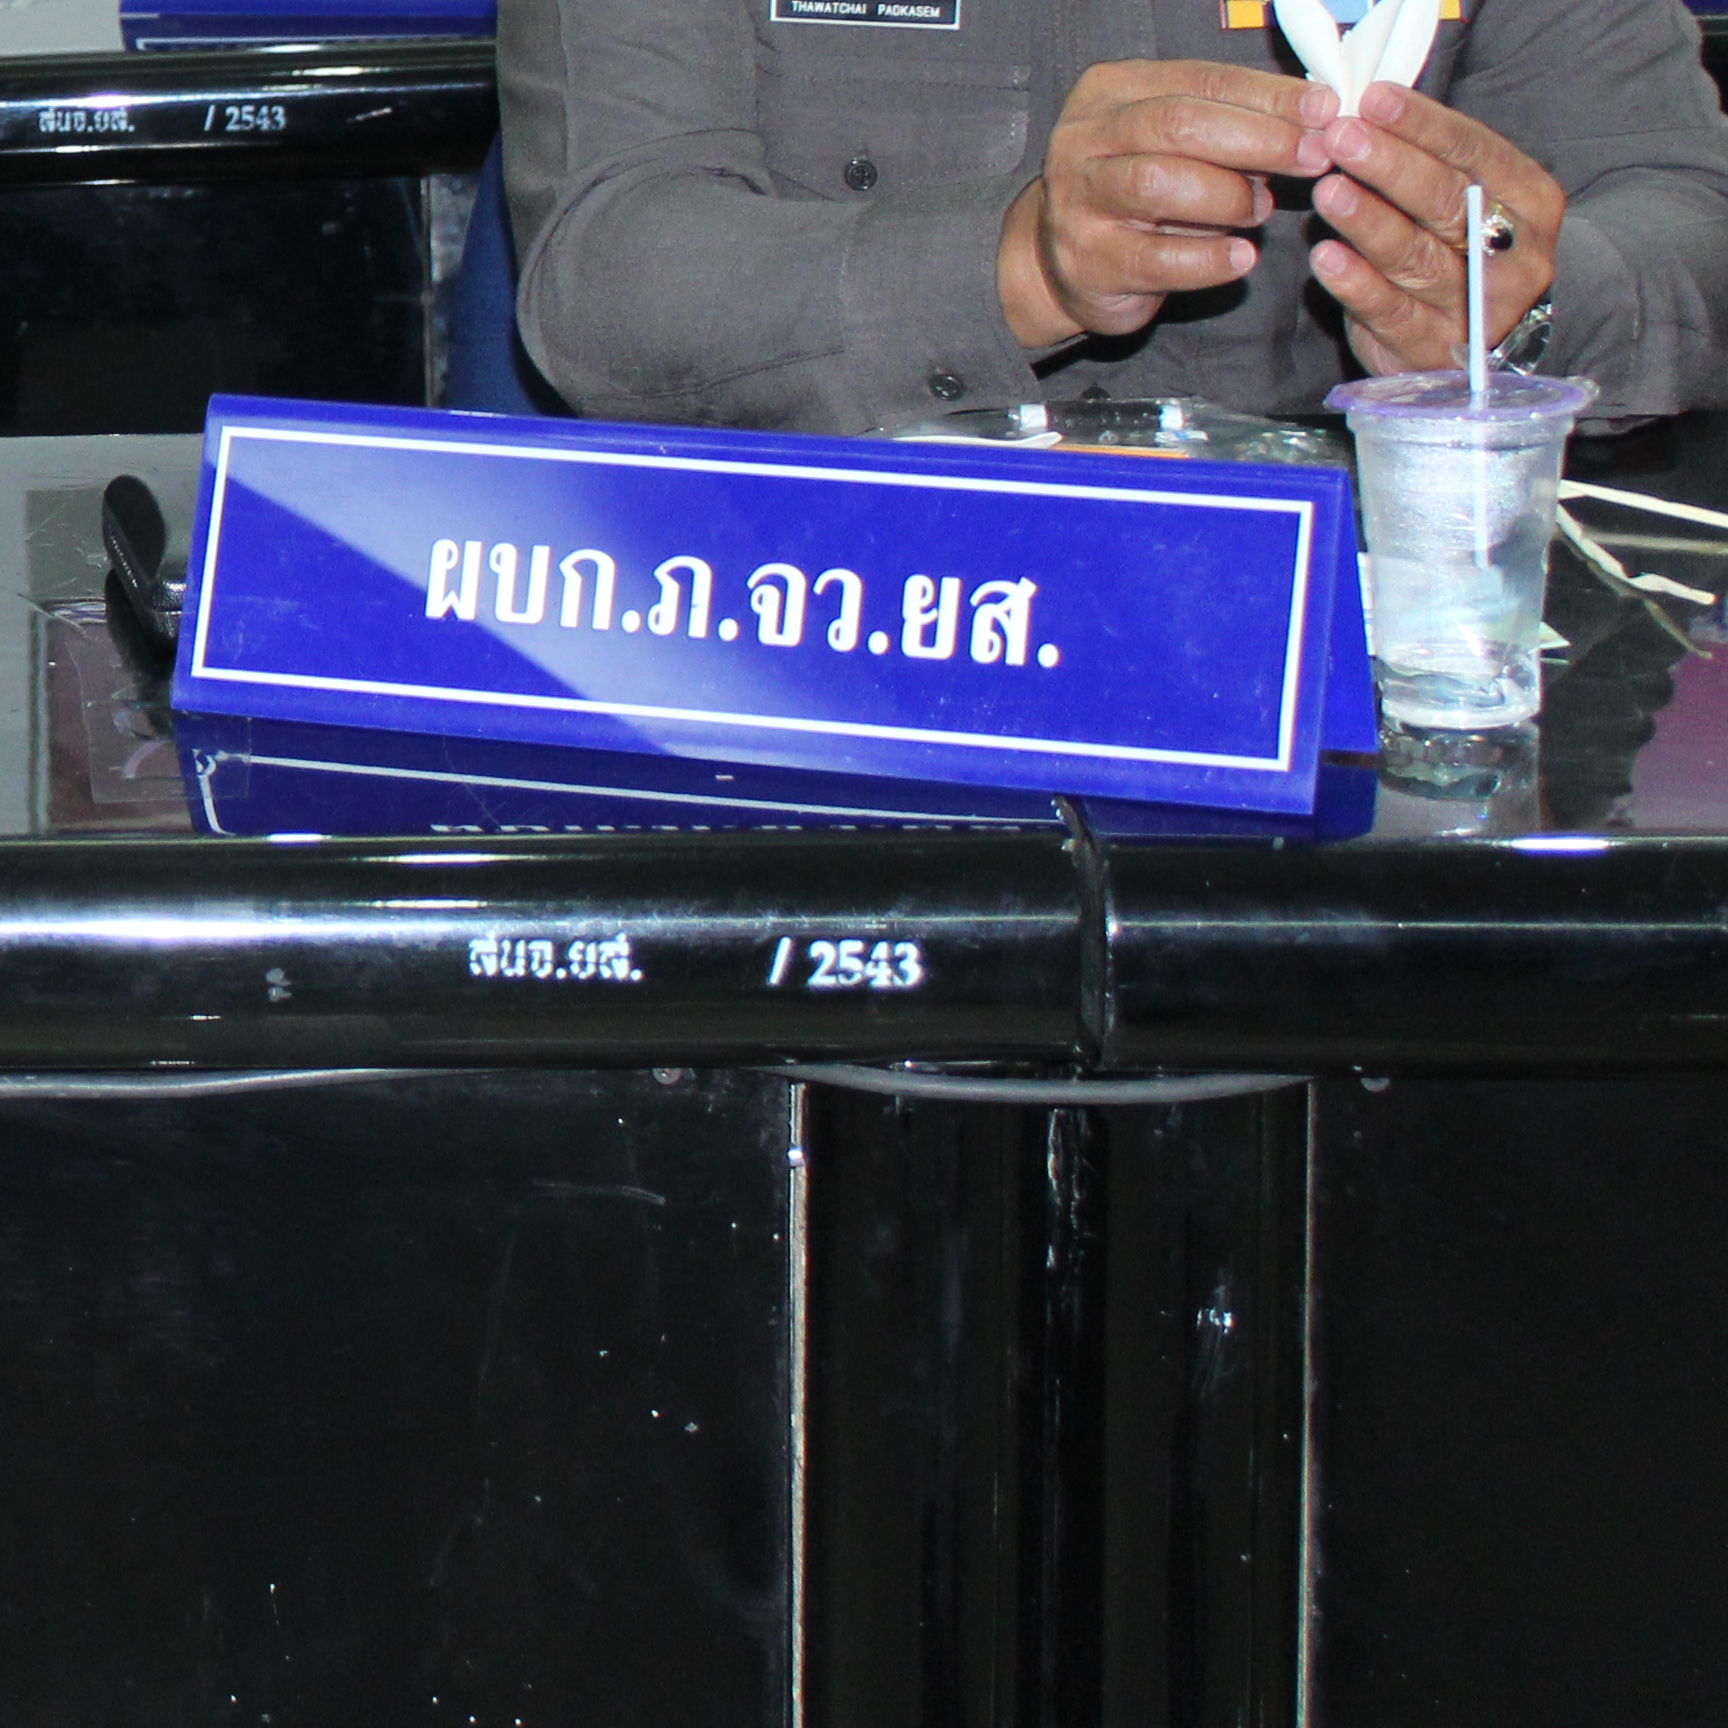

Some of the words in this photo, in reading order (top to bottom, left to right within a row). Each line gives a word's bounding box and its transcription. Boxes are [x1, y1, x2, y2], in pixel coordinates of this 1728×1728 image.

[792, 0, 867, 15] THAWATCHAI
[425, 537, 1060, 669] ผบก.ภ.จว.ยส.
